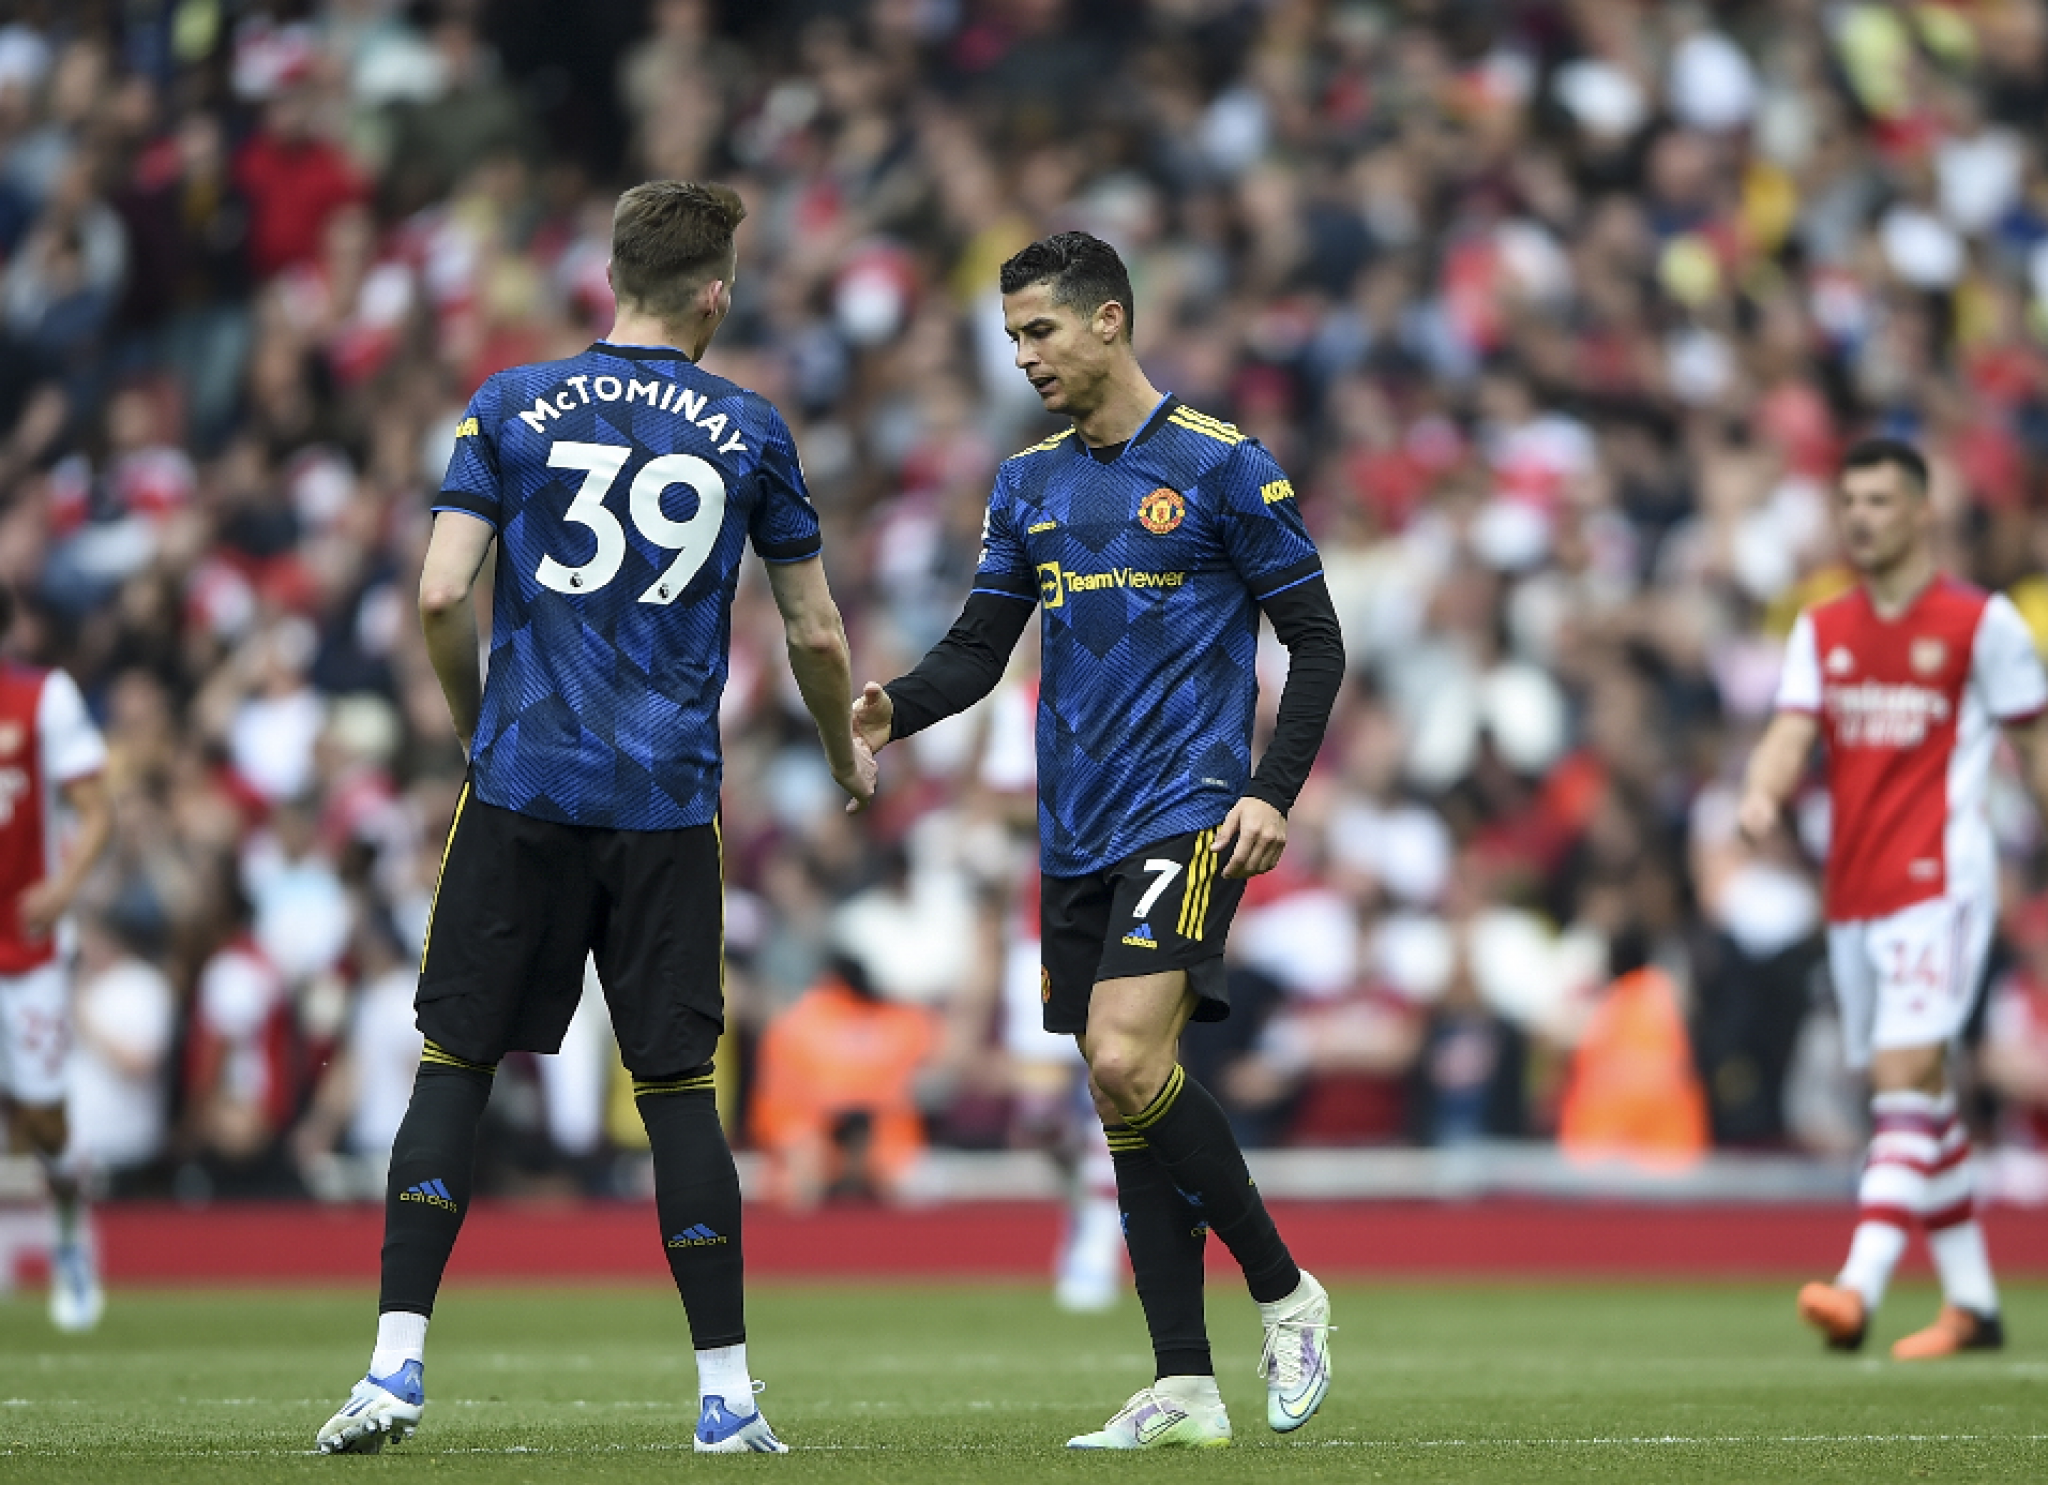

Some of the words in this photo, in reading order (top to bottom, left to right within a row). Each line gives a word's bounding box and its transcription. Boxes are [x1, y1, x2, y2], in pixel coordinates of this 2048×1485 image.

[518, 375, 748, 455] McTOMINAY
[535, 441, 726, 605] 39
[1062, 567, 1185, 592] TeamViewer
[1133, 858, 1183, 919] 7
[1121, 936, 1158, 949] adidas
[400, 1191, 457, 1214] adidas
